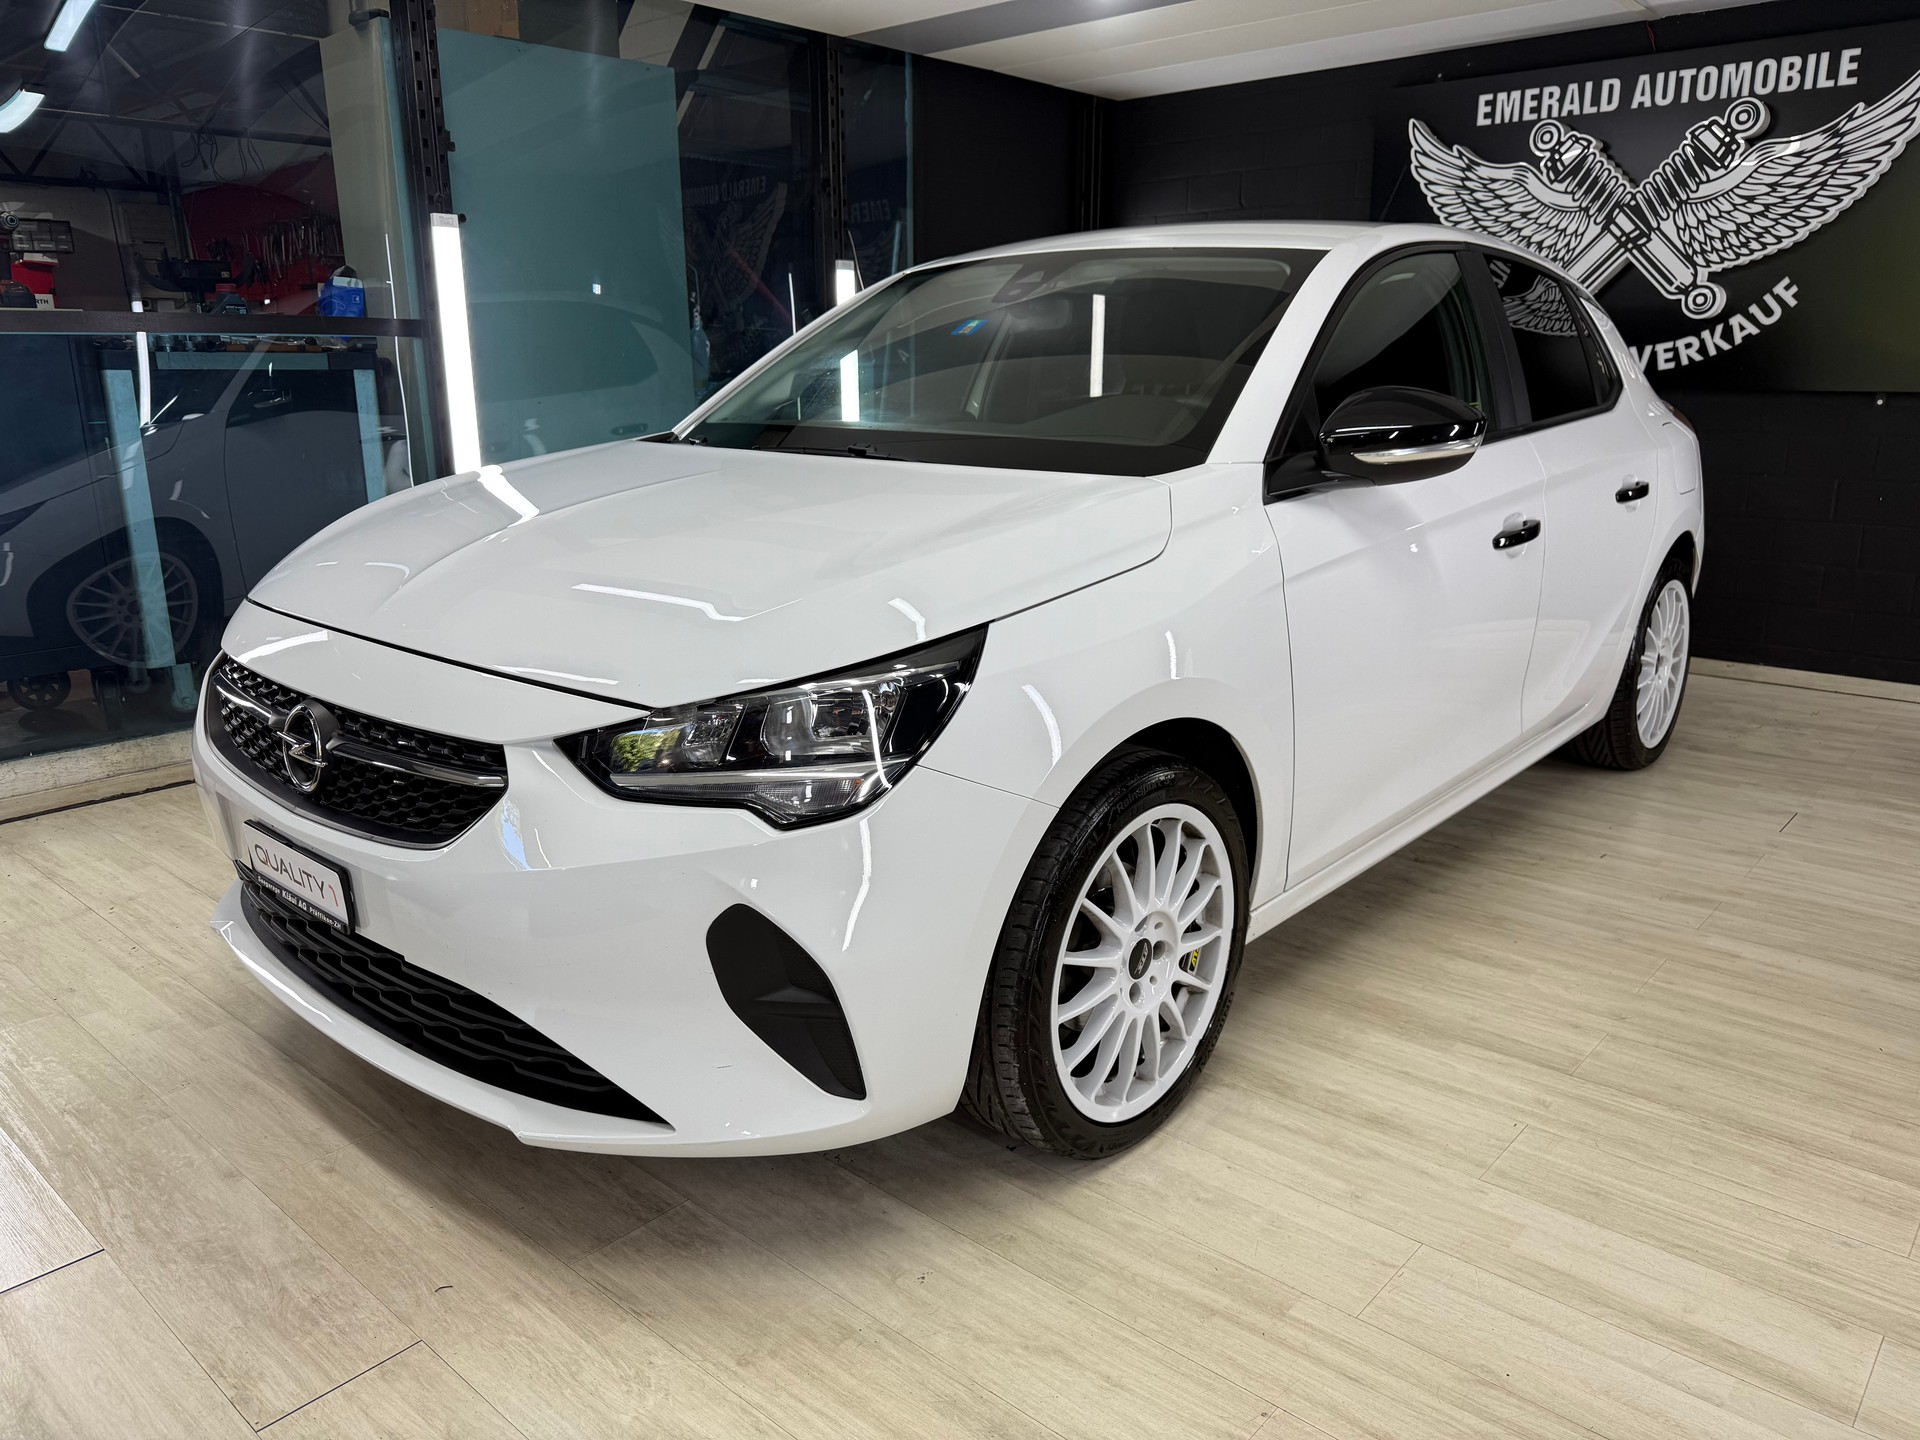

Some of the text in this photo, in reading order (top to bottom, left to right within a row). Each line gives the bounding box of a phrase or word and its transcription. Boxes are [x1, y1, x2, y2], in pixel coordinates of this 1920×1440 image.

[1476, 47, 1862, 126] EMERALD AUTOMOBILE
[1628, 275, 1799, 373] VERKAUF
